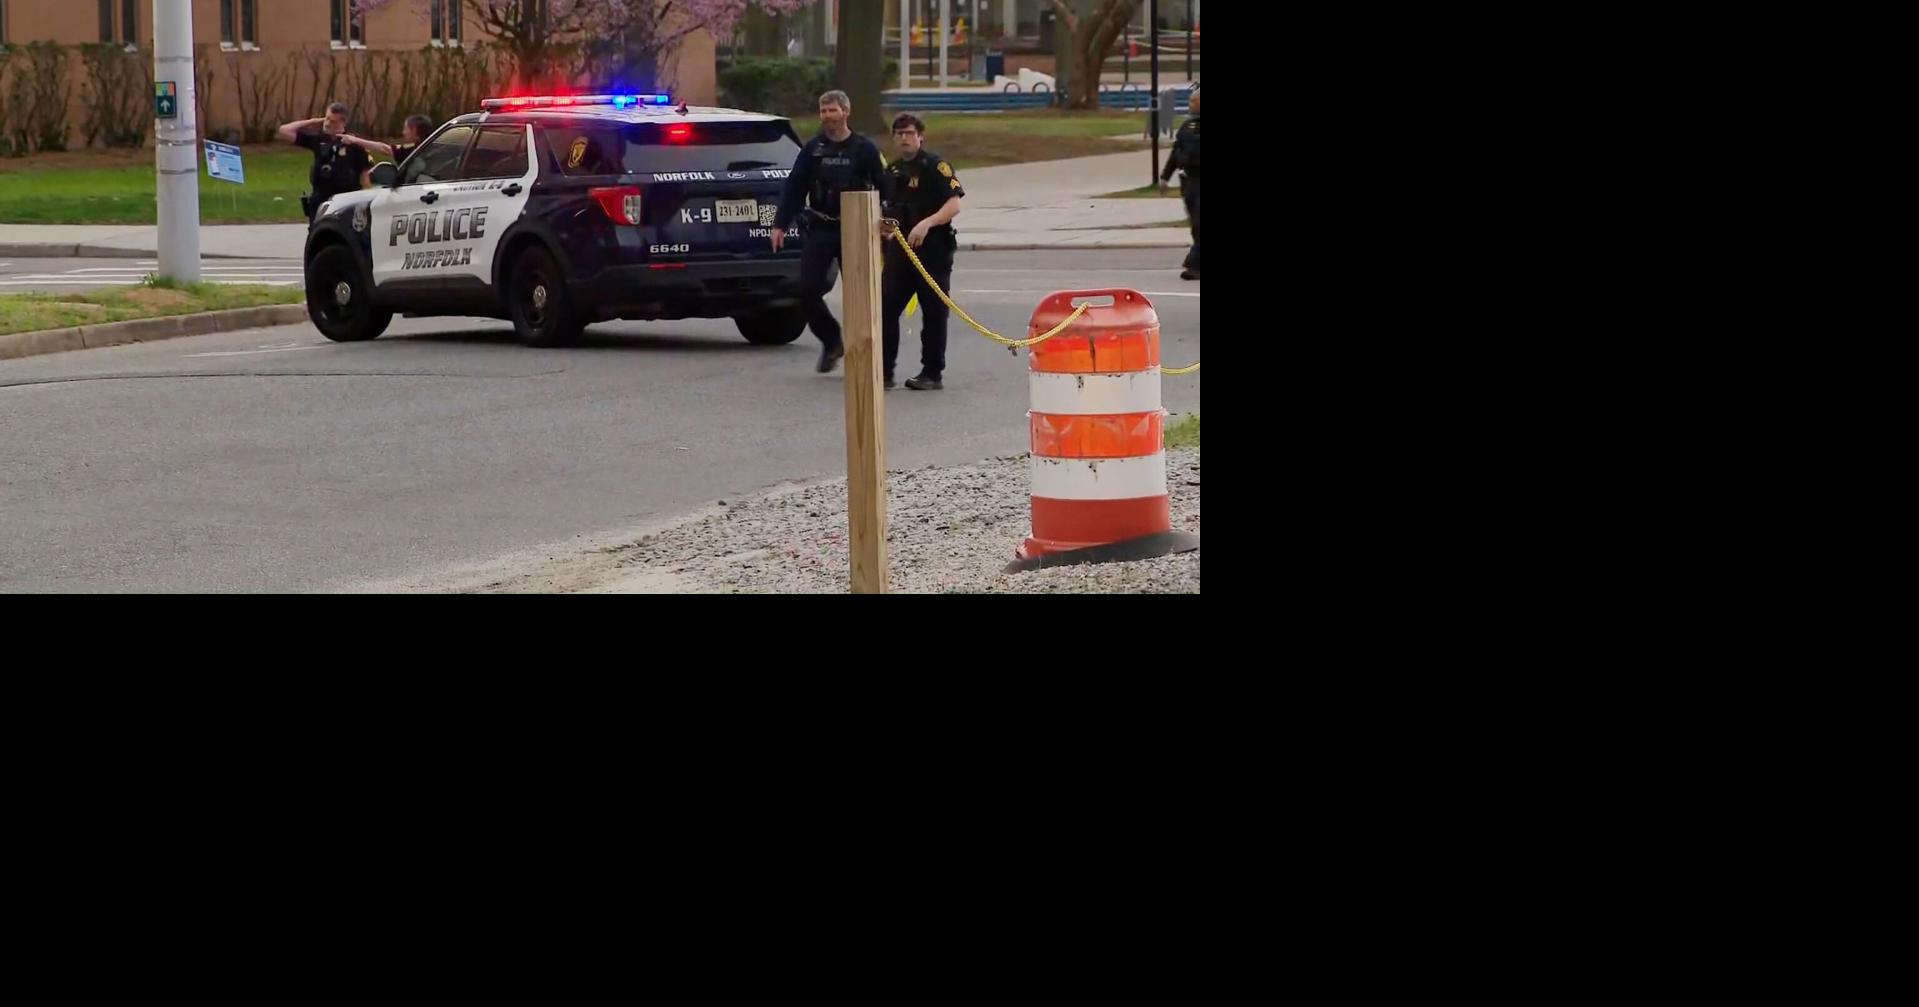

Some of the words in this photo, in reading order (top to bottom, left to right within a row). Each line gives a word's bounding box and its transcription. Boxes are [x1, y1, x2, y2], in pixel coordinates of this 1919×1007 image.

[653, 171, 716, 182] NORFOLK
[762, 169, 792, 179] POLI
[680, 208, 712, 224] K-9
[389, 206, 488, 247] POLICE
[650, 244, 690, 254] 6640
[401, 248, 472, 270] NORFOLK
